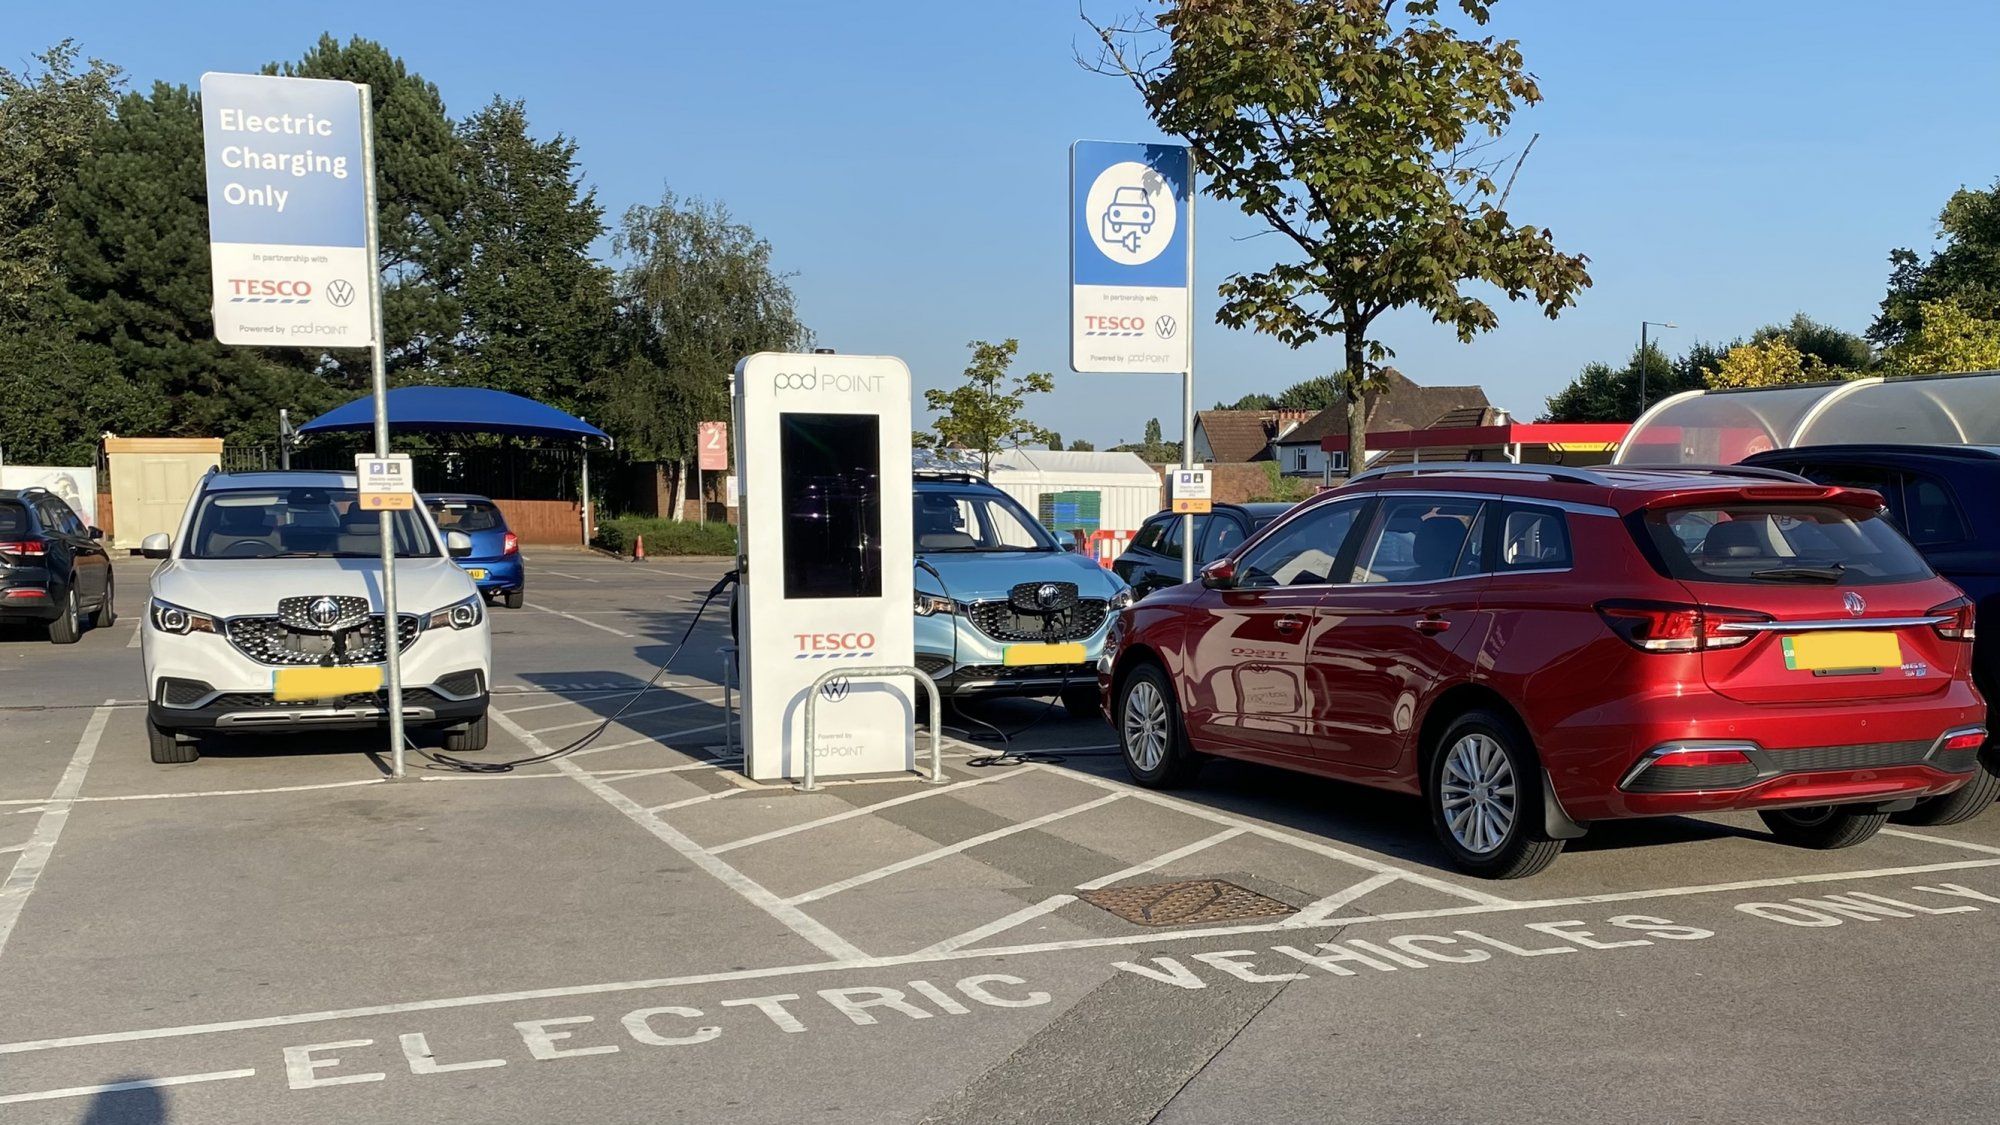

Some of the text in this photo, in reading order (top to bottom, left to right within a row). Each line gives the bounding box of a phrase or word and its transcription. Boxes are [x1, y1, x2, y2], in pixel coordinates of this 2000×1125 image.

[219, 108, 333, 136] Electric
[221, 146, 348, 179] Charging
[223, 182, 289, 213] Only
[253, 253, 328, 263] In partnership with
[228, 279, 312, 296] TESCO
[1110, 294, 1145, 302] partnership
[239, 321, 348, 336] Powered by pod POINT
[1084, 315, 1145, 330] TESCO
[1118, 354, 1124, 362] by
[1145, 354, 1170, 363] POINT
[774, 365, 885, 397] pod POINT
[706, 428, 720, 449] 2
[793, 632, 876, 650] TESCO
[817, 732, 853, 741] Powered by
[814, 745, 865, 758] od POINT
[282, 883, 2000, 1090] ELECTRIC VEHICLES ONLY
